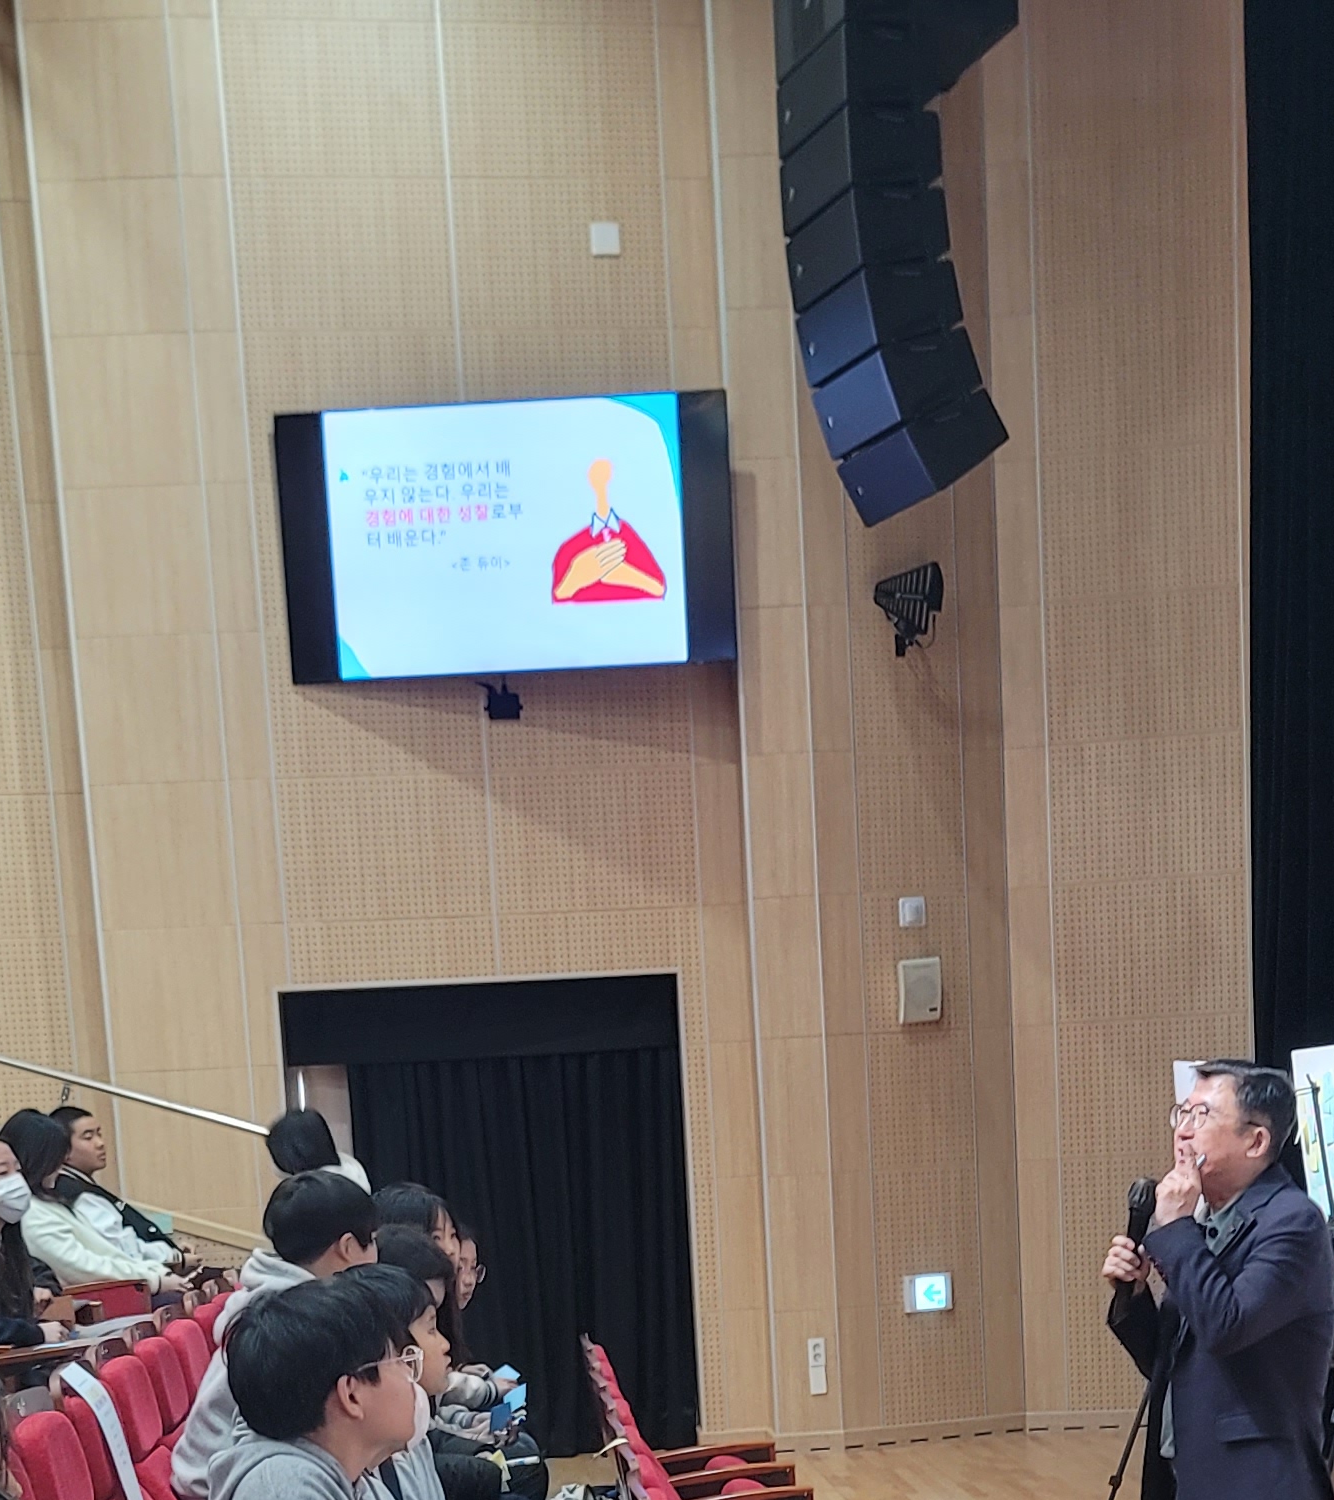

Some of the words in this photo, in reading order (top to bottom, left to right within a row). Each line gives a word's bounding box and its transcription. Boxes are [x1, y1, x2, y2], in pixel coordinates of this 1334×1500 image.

[425, 461, 490, 481] 경험에서
[496, 459, 511, 478] 배
[365, 487, 395, 506] 우지
[462, 482, 509, 501] 우리는
[366, 507, 414, 528] 경험에
[420, 505, 451, 525] 대한
[367, 532, 381, 549] 터
